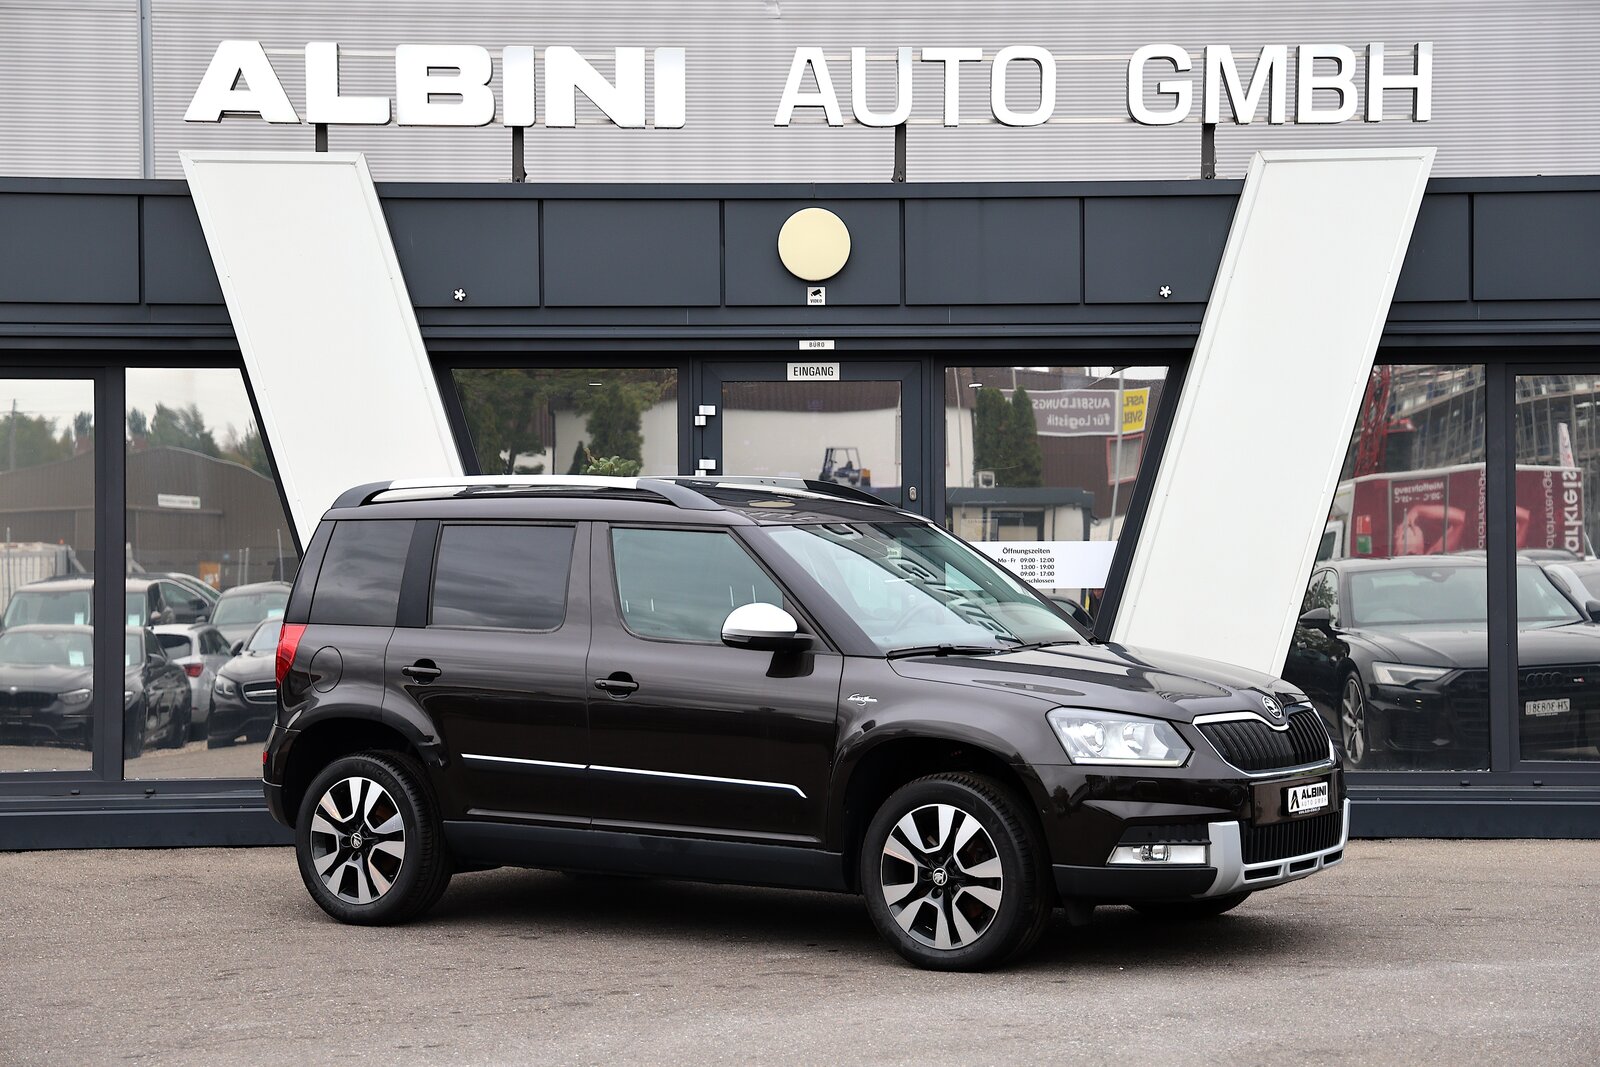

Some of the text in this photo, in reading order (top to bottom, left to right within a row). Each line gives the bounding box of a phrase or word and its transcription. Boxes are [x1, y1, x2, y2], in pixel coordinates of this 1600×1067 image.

[183, 40, 1433, 129] ALBINI AUTO GMBH
[809, 340, 825, 348] BÜRO
[793, 366, 834, 377] EINGANG
[1002, 547, 1050, 555] Öffnungszeiten
[1301, 785, 1326, 800] ALBINI
